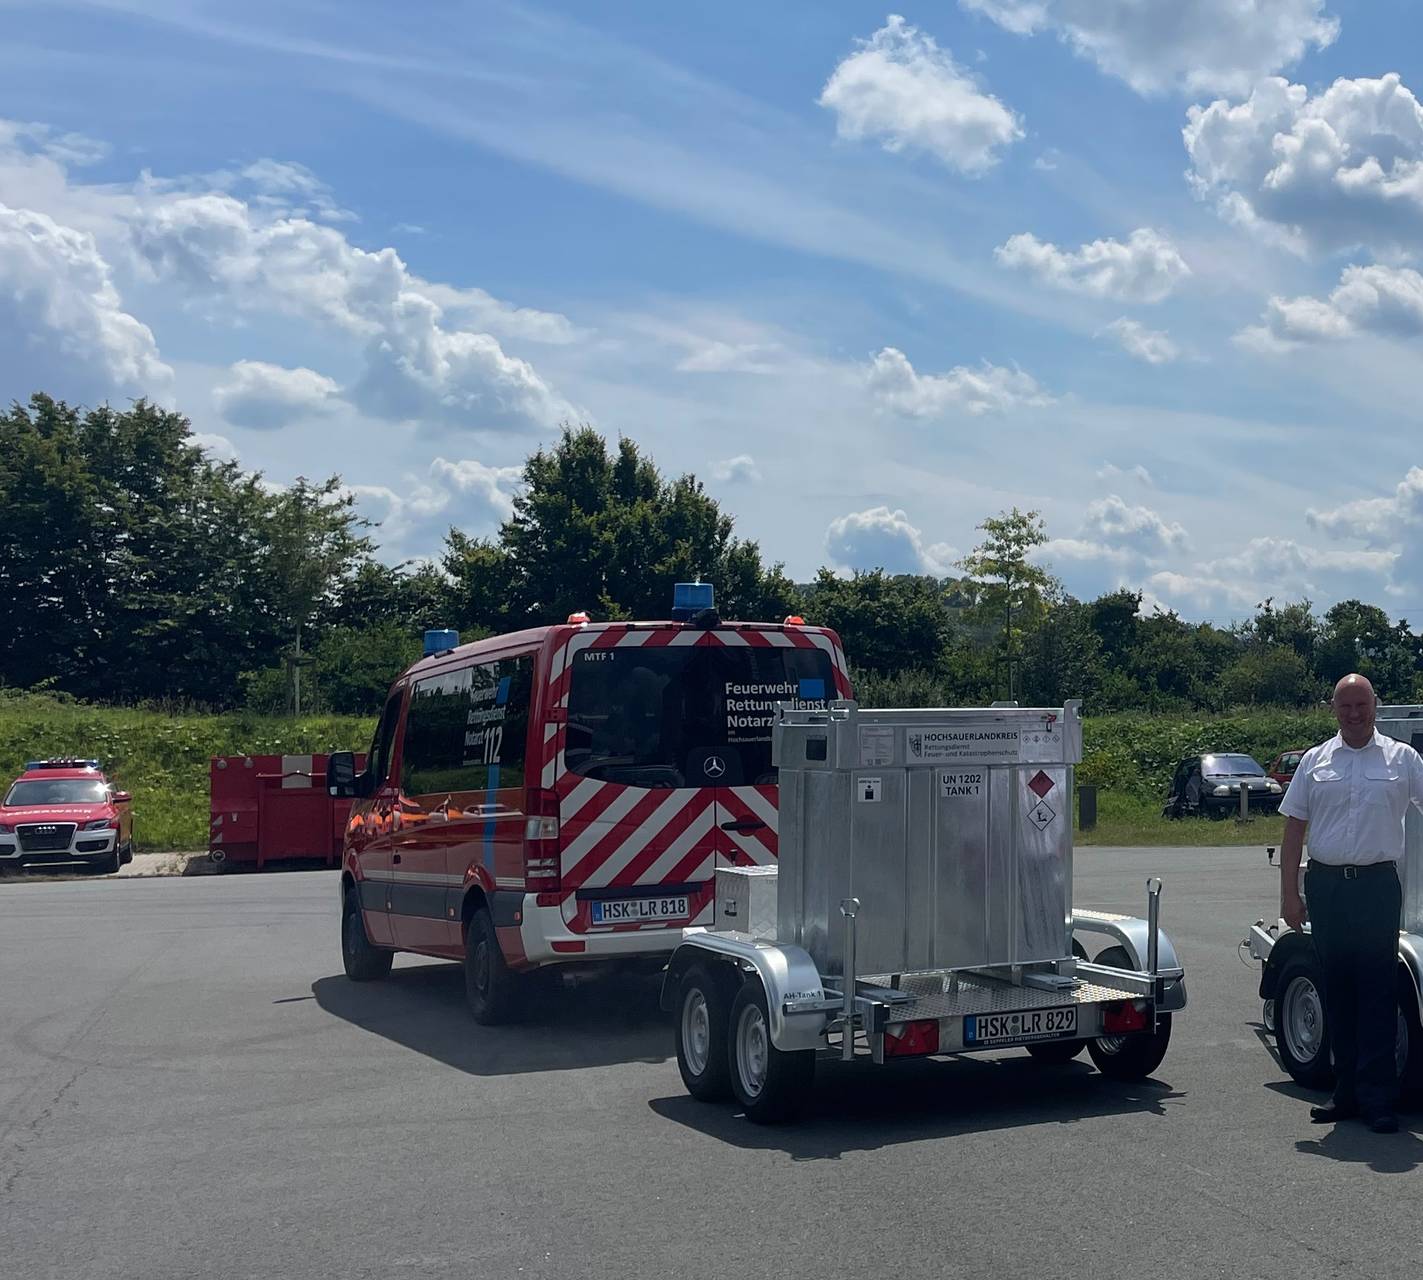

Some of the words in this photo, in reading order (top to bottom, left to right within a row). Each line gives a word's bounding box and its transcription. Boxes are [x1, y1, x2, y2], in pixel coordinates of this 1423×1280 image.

[584, 652, 607, 661] MTF
[609, 652, 615, 660] 1
[725, 682, 798, 695] Feuerwehr
[727, 698, 825, 711] Rettunienst
[727, 715, 776, 727] Notarz
[924, 732, 1018, 741] HOCHSAUERLANDKREIS
[484, 726, 502, 764] 112
[943, 776, 957, 784] UN
[959, 775, 981, 784] 1202
[946, 786, 972, 796] TANK
[975, 786, 979, 795] 1
[603, 902, 630, 919] HSK
[640, 901, 657, 916] LR
[661, 899, 686, 915] 818
[978, 1016, 1009, 1038] HSK
[1022, 1013, 1041, 1033] LR
[1046, 1010, 1074, 1031] 829
